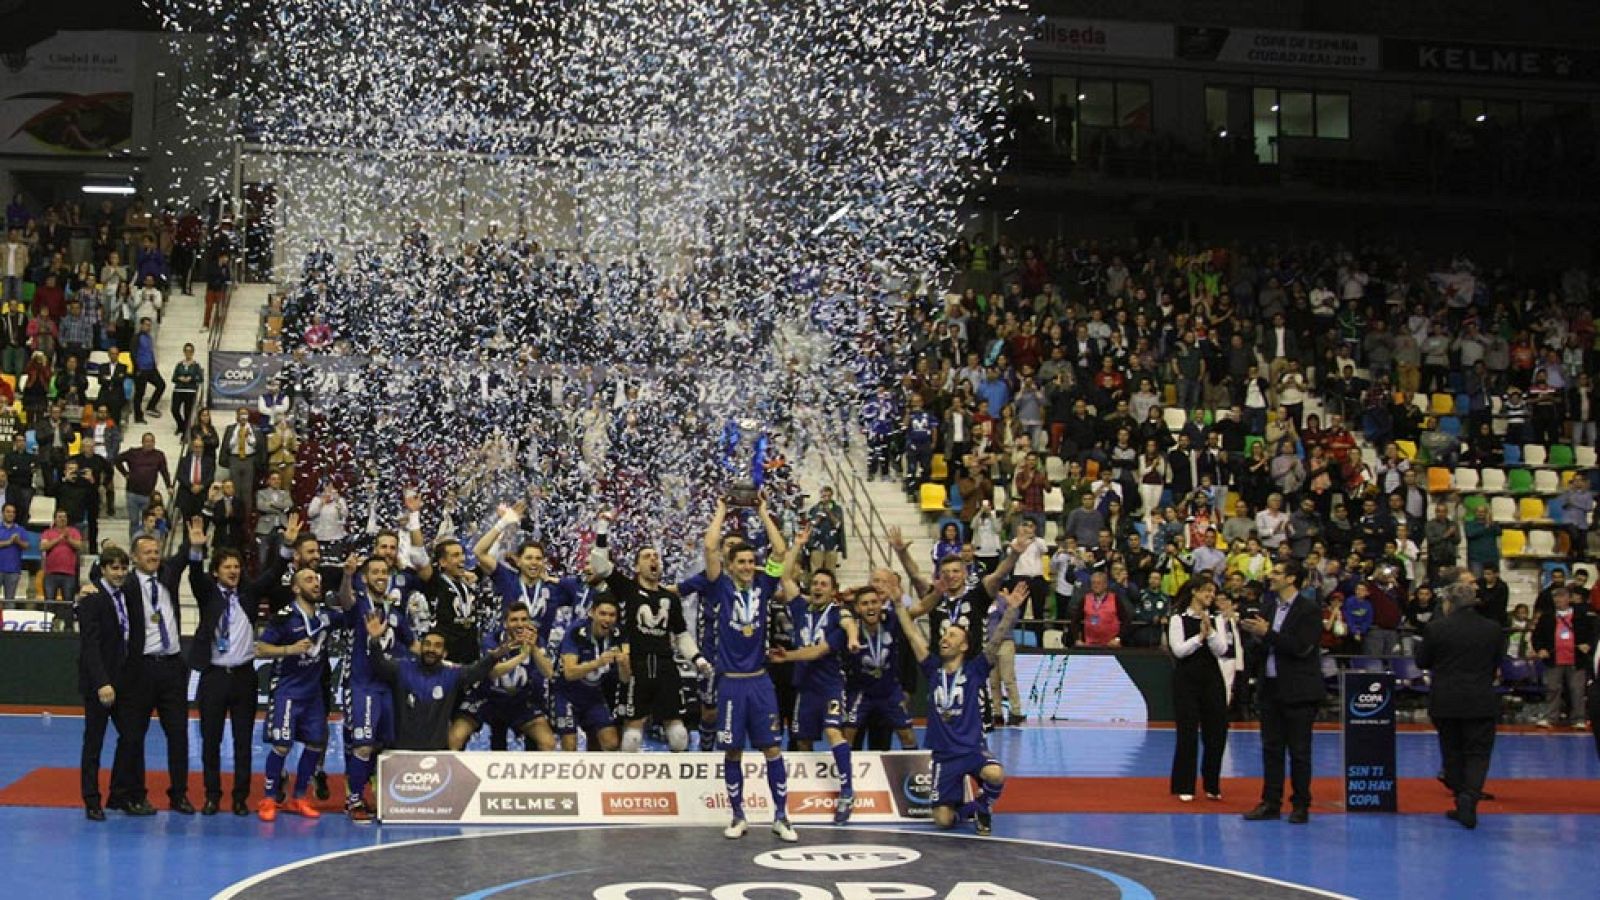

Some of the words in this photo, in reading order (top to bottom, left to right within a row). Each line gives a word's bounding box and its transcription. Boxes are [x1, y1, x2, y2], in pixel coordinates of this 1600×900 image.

[1418, 46, 1541, 73] KELME
[487, 759, 605, 780] CAMPEÓN
[611, 763, 672, 780] COPA
[679, 763, 708, 779] DE
[714, 760, 809, 779] EPAA
[815, 762, 872, 779] 207
[1348, 765, 1369, 777] SIN
[1371, 765, 1384, 777] TI
[402, 772, 440, 784] COPA
[1348, 780, 1366, 791] NO
[1368, 780, 1393, 791] HAY
[487, 798, 556, 810] KELME
[610, 797, 669, 809] MOTRIO
[1348, 794, 1380, 806] COPA
